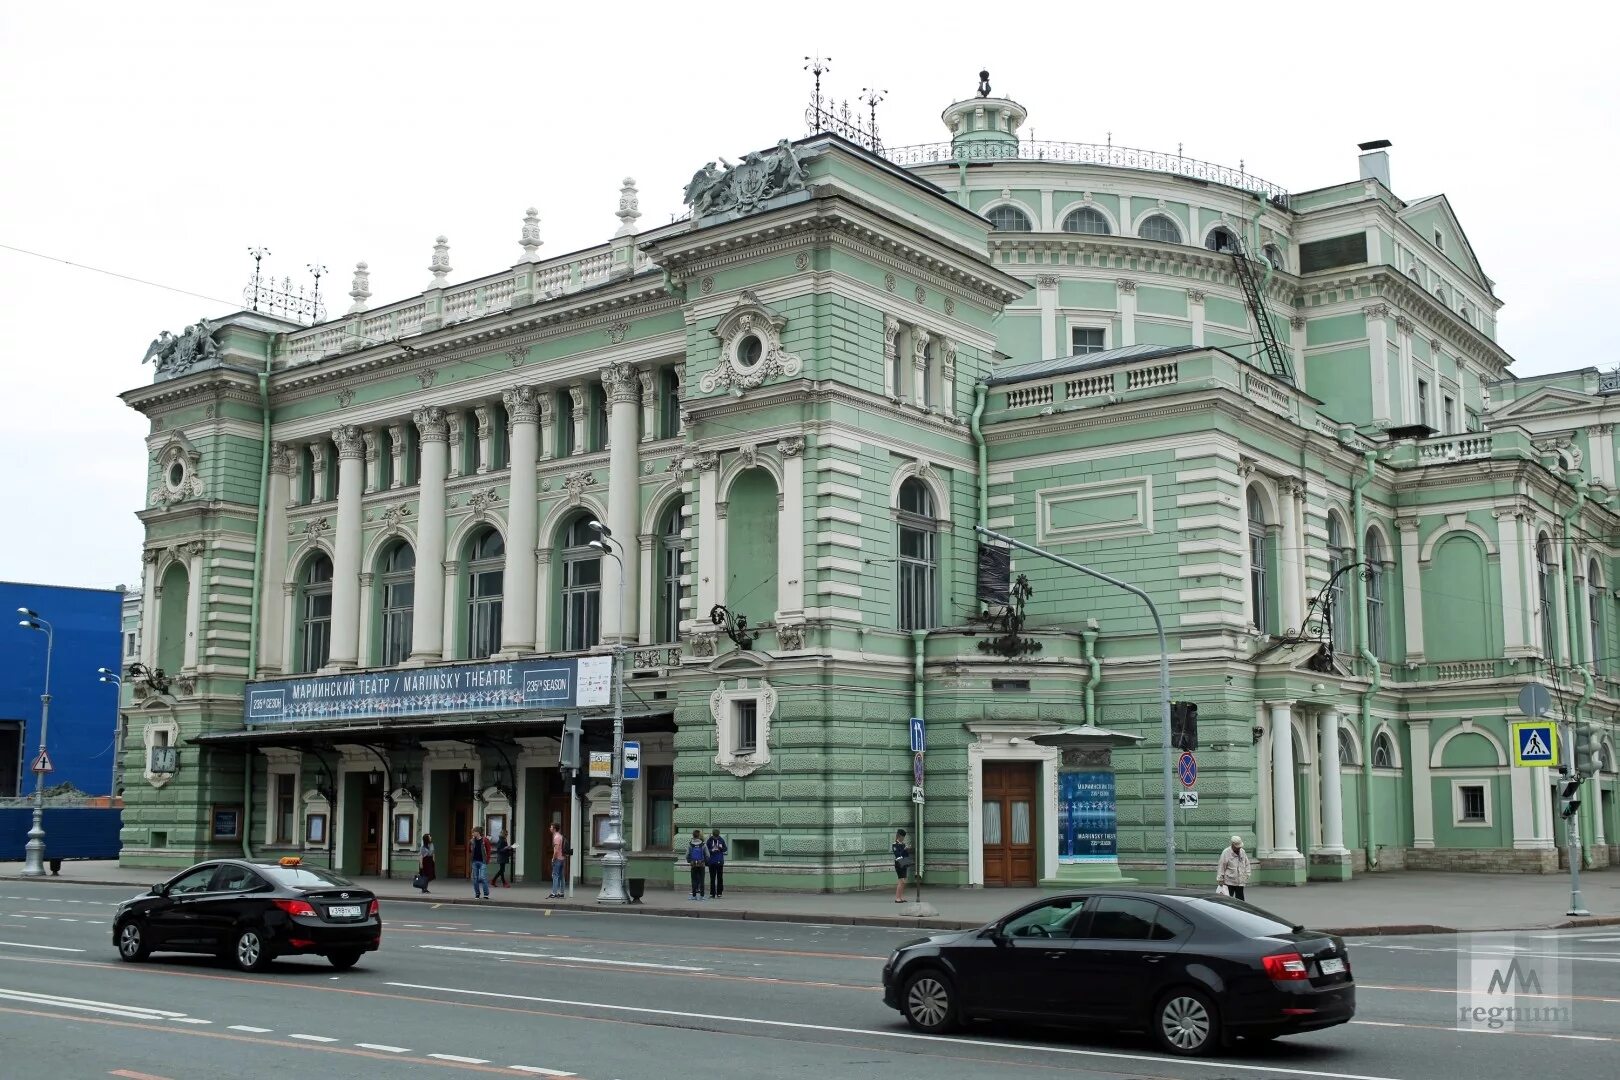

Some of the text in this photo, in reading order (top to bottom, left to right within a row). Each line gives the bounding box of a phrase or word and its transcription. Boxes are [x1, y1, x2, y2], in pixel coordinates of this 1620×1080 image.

[293, 678, 354, 699] МАРИИНСКИЙ
[359, 678, 390, 695] ТЕАТР
[403, 668, 513, 692] MARIINSKY THEATRE
[543, 678, 567, 691] SEASON
